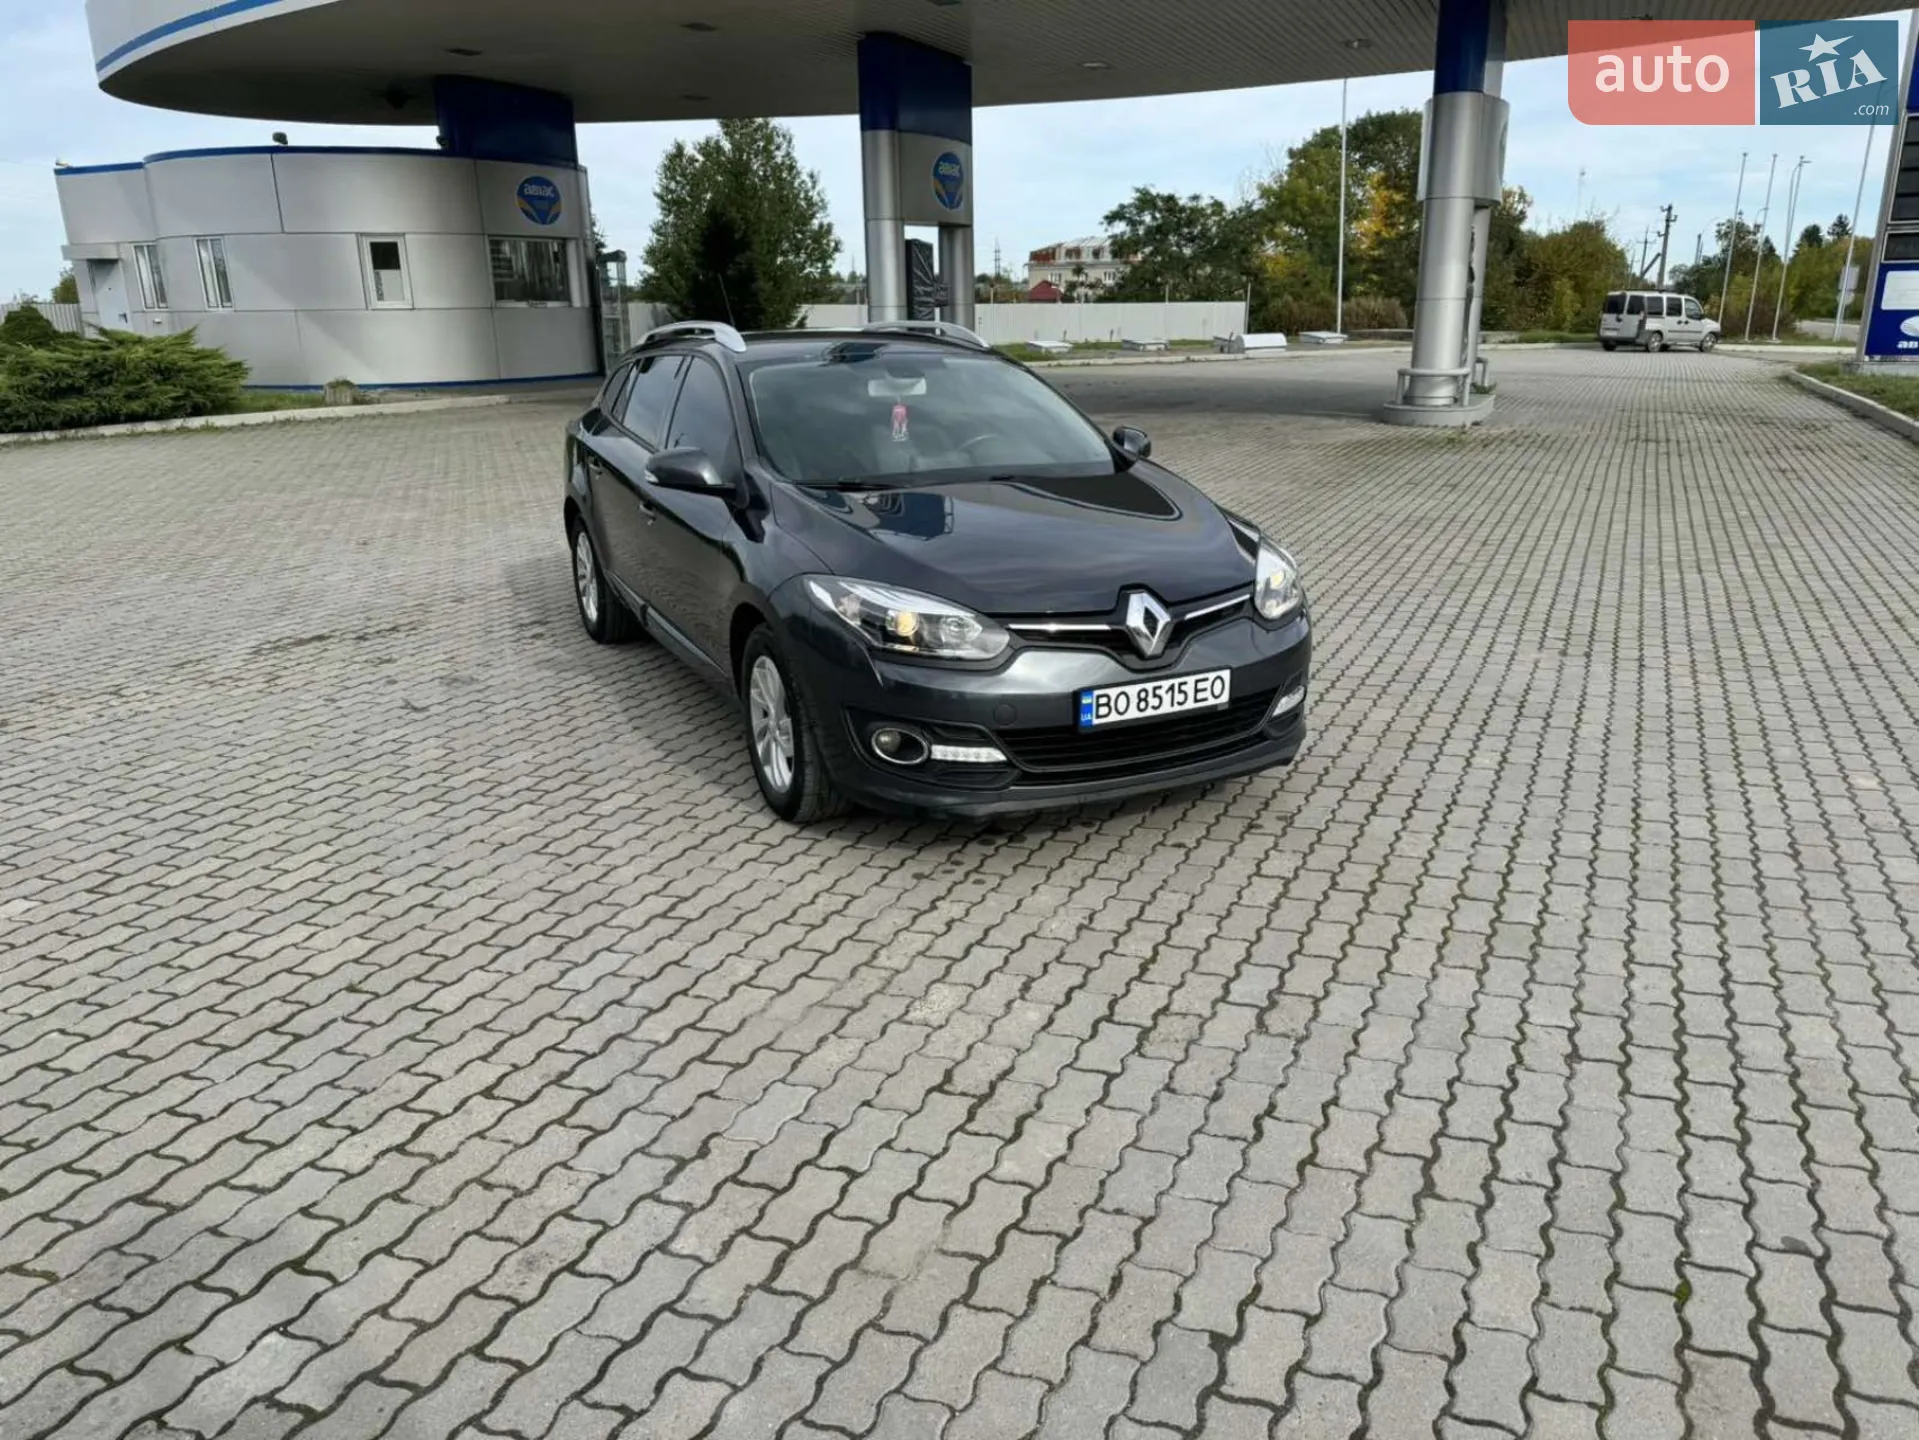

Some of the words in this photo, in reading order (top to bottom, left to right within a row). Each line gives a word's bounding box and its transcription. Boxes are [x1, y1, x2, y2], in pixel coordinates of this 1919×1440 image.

[1095, 691, 1130, 719] BO
[1136, 681, 1188, 713] 8515
[1193, 675, 1225, 704] EO
[1080, 713, 1092, 722] UA
